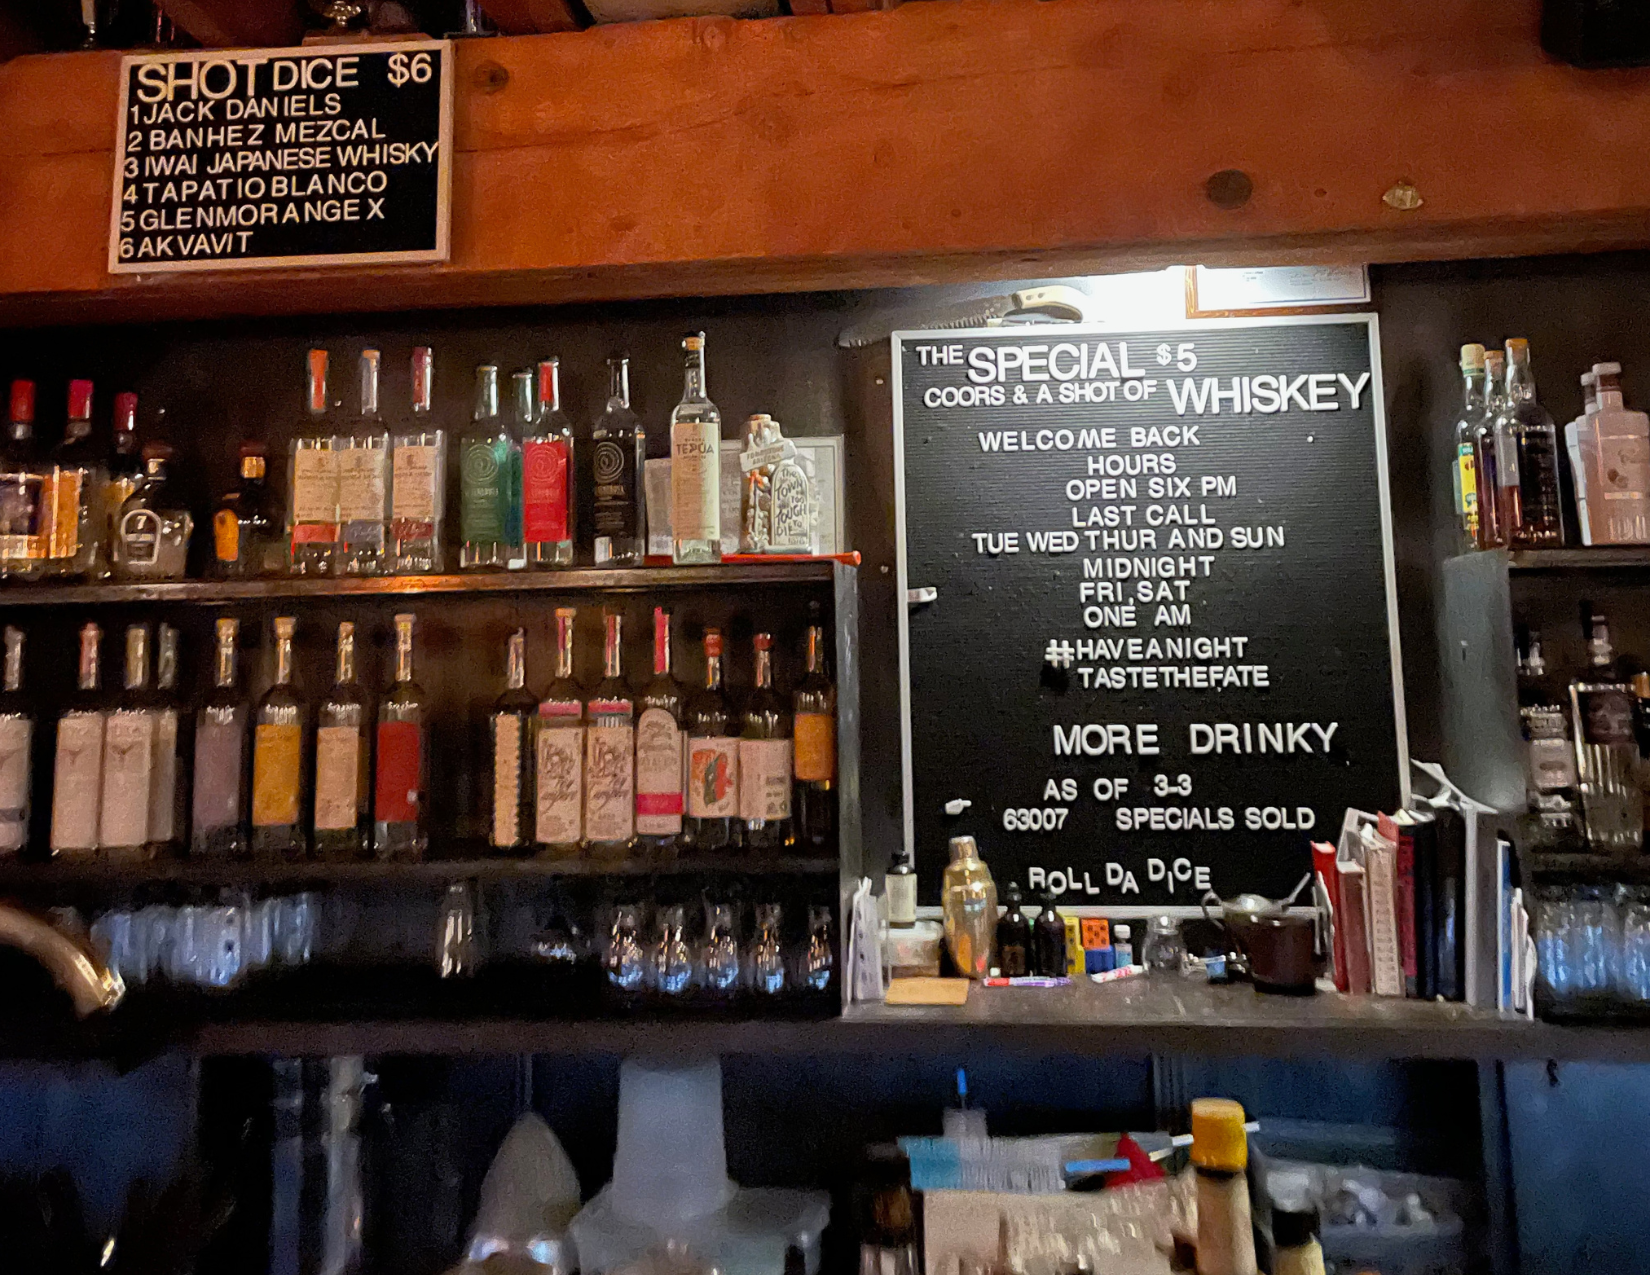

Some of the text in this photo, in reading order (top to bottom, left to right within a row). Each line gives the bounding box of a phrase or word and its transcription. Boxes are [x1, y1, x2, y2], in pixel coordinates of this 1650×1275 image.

[136, 52, 432, 103] SHOT DICE $6
[226, 93, 341, 121] DANIELS
[128, 118, 386, 152] 2 BANHEZ MEZCAL
[124, 142, 439, 177] 3 IWAI JAPANESE WHISKY
[124, 171, 387, 203] 4 TAPATIO BLANCO
[122, 198, 386, 231] 5 GLENMORANGE X
[121, 232, 253, 258] 6 AKVAVIT
[916, 344, 964, 366] THE
[967, 342, 1146, 383] SPECIAL
[924, 372, 1370, 415] COORS & A SHOT OF WHISKEY
[978, 426, 1201, 452] WELCOME BACK
[1088, 453, 1176, 475] HOURS
[775, 479, 803, 501] TOWN
[1066, 475, 1237, 500] OPEN SIX PM
[776, 504, 807, 526] TOUGH
[1072, 504, 1216, 528] LAST CALL
[972, 526, 1285, 554] TUE WED THUR AND SUN
[1083, 556, 1215, 578] MIDNIGHT
[1083, 605, 1191, 628] ONE AM
[1053, 722, 1339, 756] MORE DRINKY
[1044, 774, 1193, 801] AS OF 3-3
[1002, 806, 1315, 830] 63007 SPECIALS SOLD
[1028, 857, 1212, 895] ROLL DA DICE
